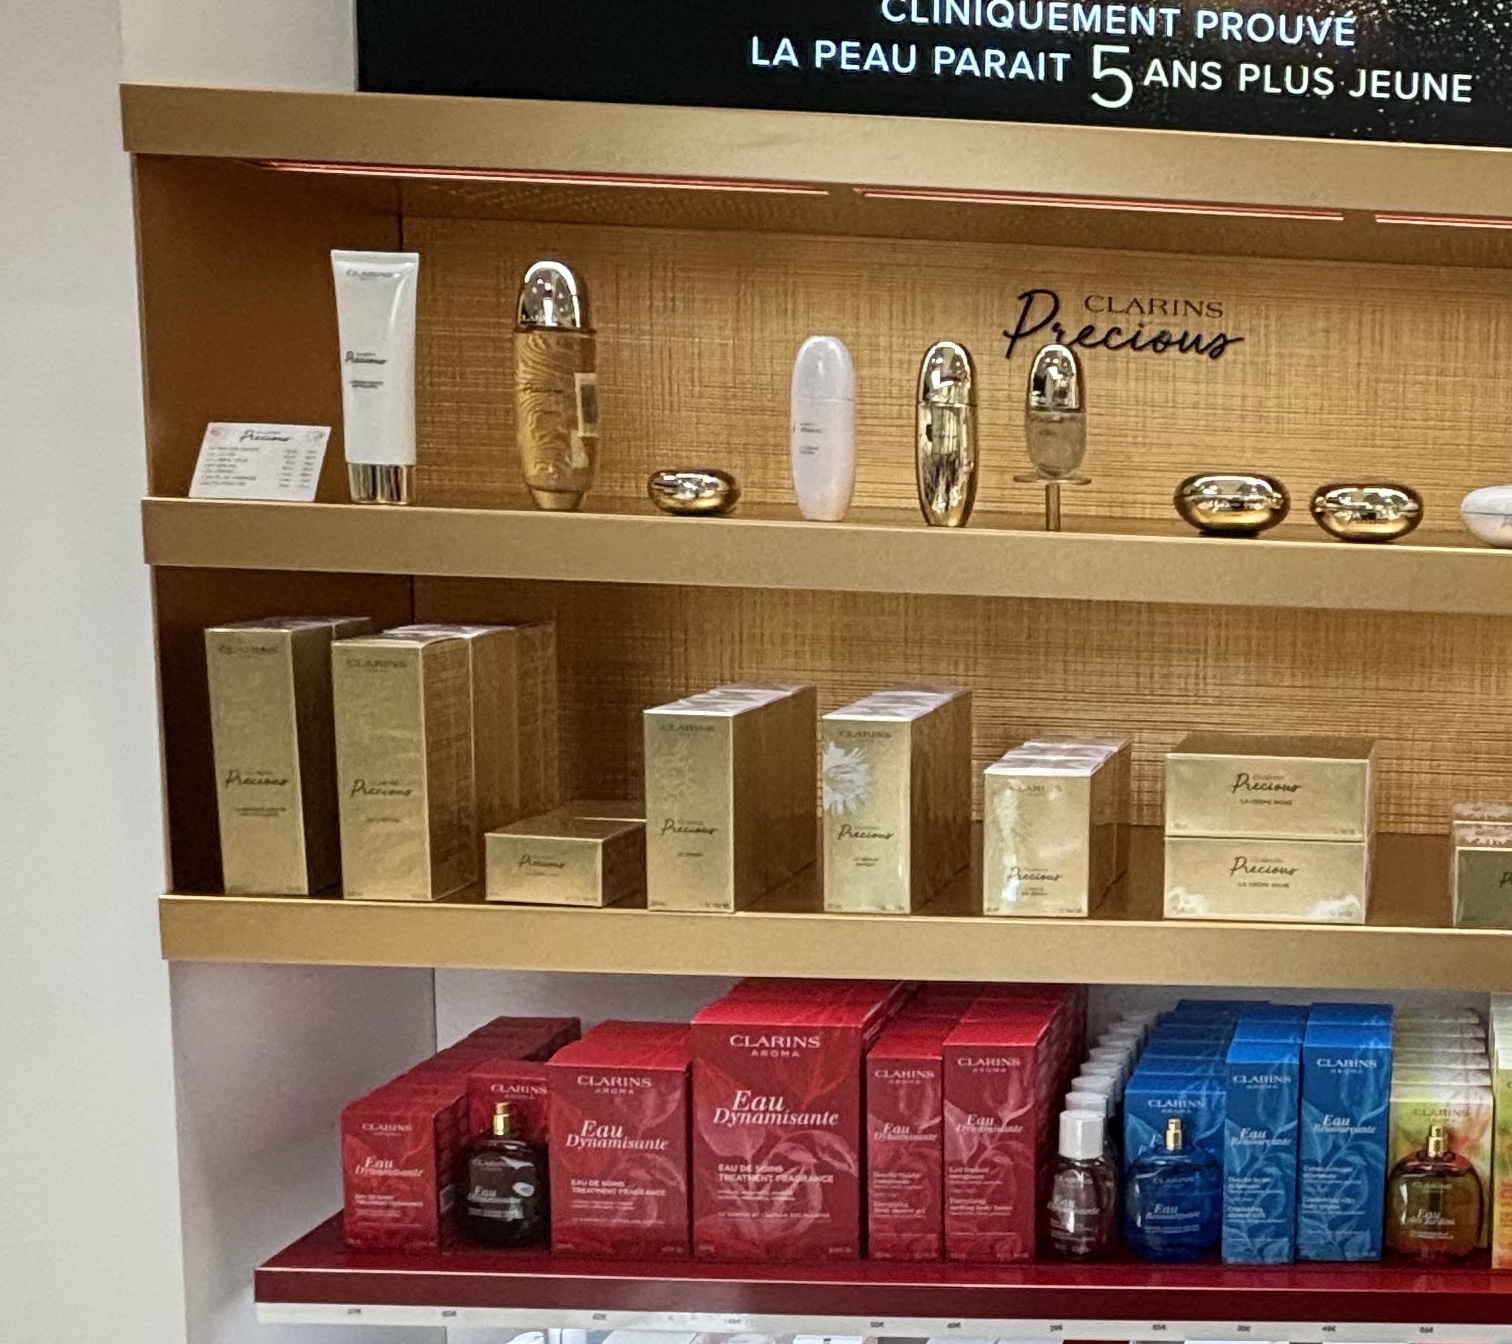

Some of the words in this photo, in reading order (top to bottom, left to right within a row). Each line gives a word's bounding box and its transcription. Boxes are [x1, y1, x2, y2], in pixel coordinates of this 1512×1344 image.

[1197, 7, 1356, 48] PROUVÉ
[752, 35, 799, 68] LA
[815, 39, 917, 74] PEAU
[934, 47, 1071, 82] PARAIT
[1090, 44, 1135, 109] 5
[1144, 59, 1223, 91] ANS
[1240, 64, 1334, 96] PLUS
[1349, 68, 1473, 102] JEUNE
[1084, 294, 1224, 318] CLARINS
[1002, 288, 1245, 360] Precious
[1231, 773, 1302, 794] Precious
[1230, 856, 1300, 877] Precious
[729, 1035, 821, 1050] CLARINS
[751, 1049, 800, 1058] AROMA
[957, 1058, 1021, 1068] CLARINS
[1316, 1058, 1377, 1069] CLARINS
[577, 1075, 652, 1088] CLARINS
[874, 1070, 935, 1080] CLARINS
[1233, 1073, 1291, 1085] CLARINS
[490, 1083, 547, 1095] CLARINS
[732, 1090, 785, 1112] Eau
[713, 1108, 839, 1128] Dynamisante
[966, 1113, 994, 1126] Eau
[1322, 1114, 1351, 1126] Eau
[581, 1120, 624, 1140] Eau
[883, 1122, 910, 1135] Eau
[1240, 1128, 1267, 1140] Eau
[565, 1134, 670, 1151] Dynamisante
[364, 1156, 394, 1170] Eau
